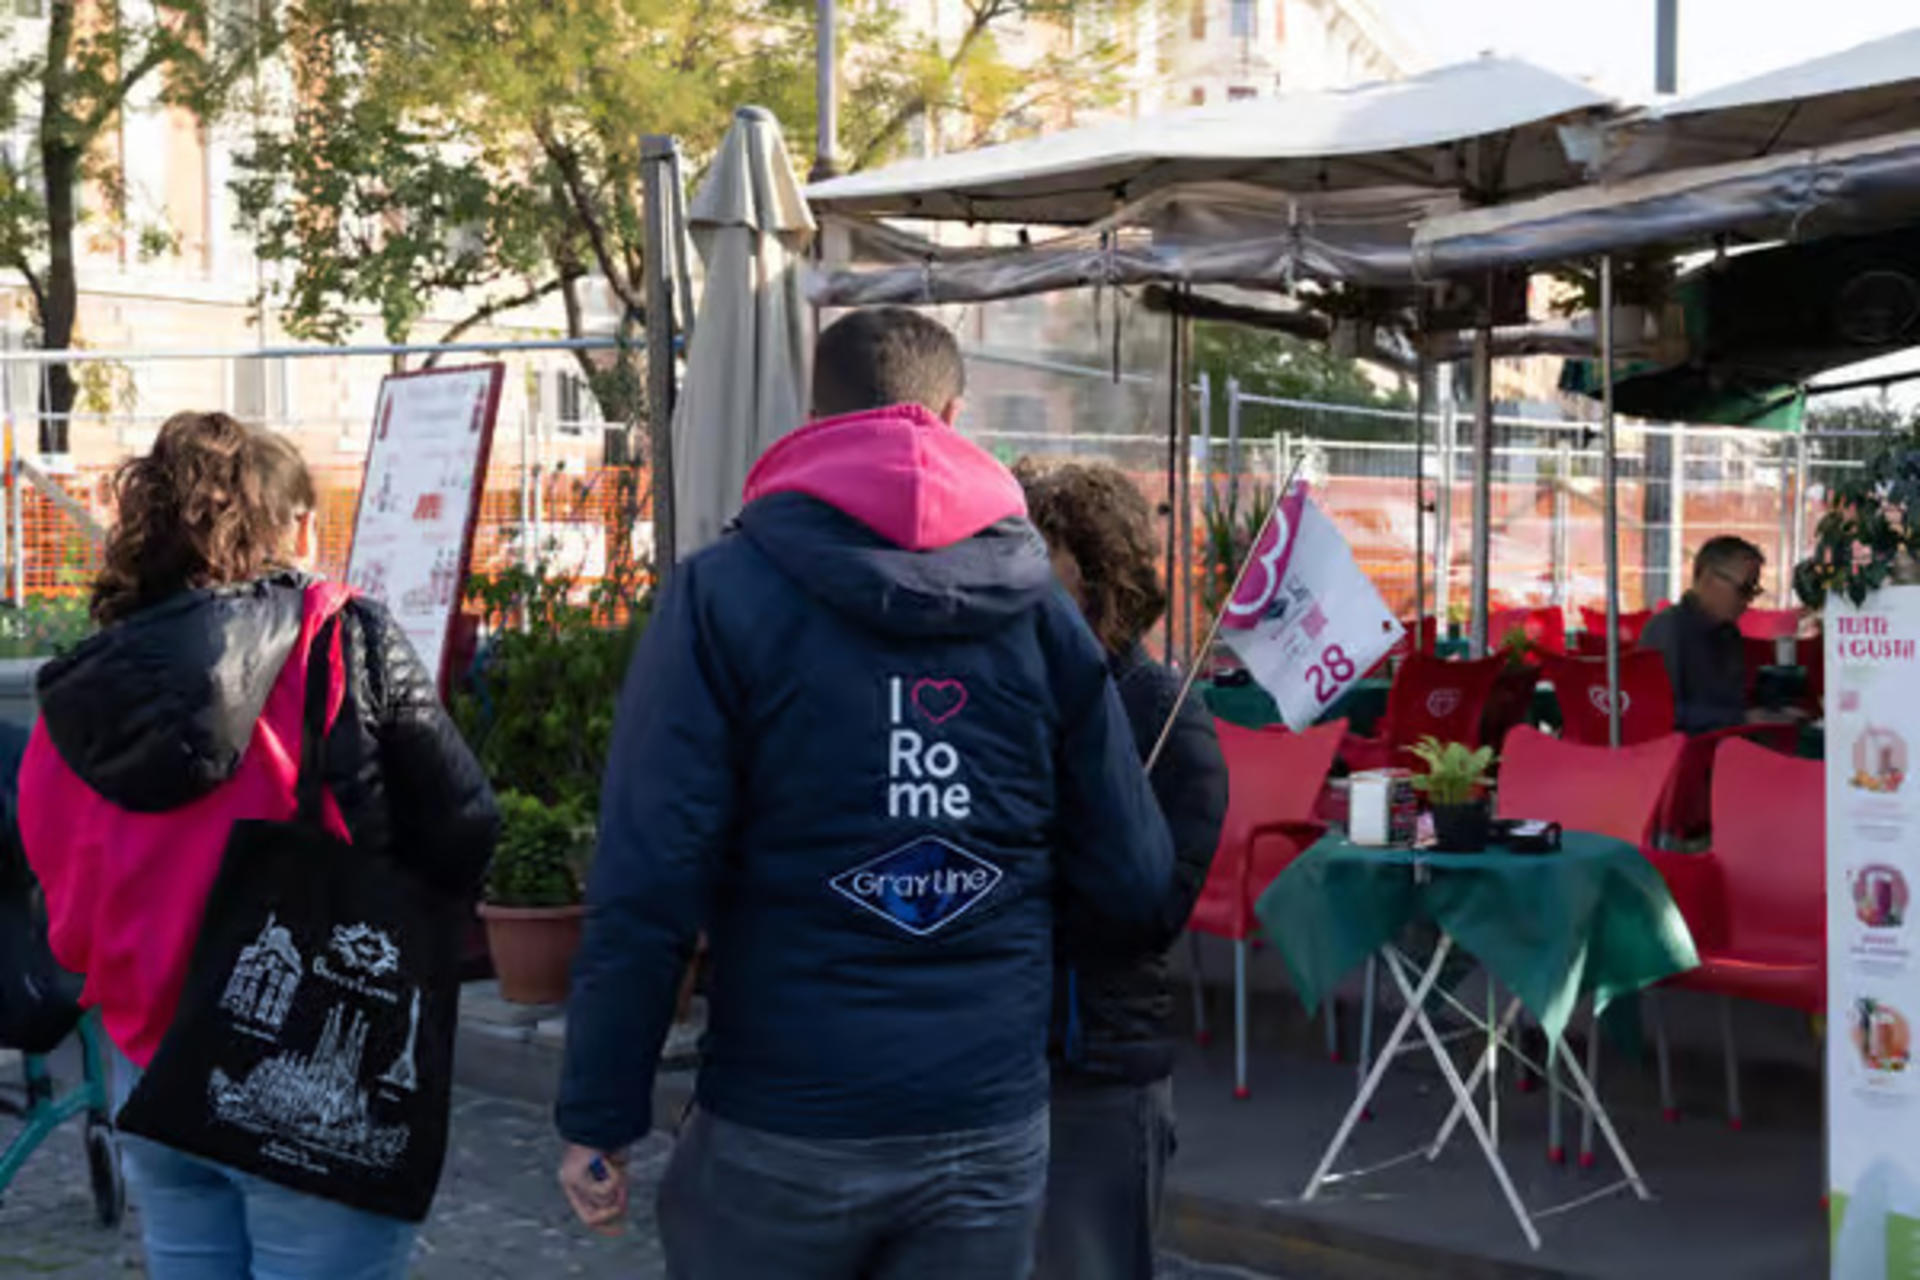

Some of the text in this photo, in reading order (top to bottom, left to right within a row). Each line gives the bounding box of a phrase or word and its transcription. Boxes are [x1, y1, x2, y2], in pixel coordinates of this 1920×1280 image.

[1305, 645, 1355, 703] 28
[891, 677, 902, 724] I
[890, 729, 959, 778] Ro
[888, 782, 971, 819] me
